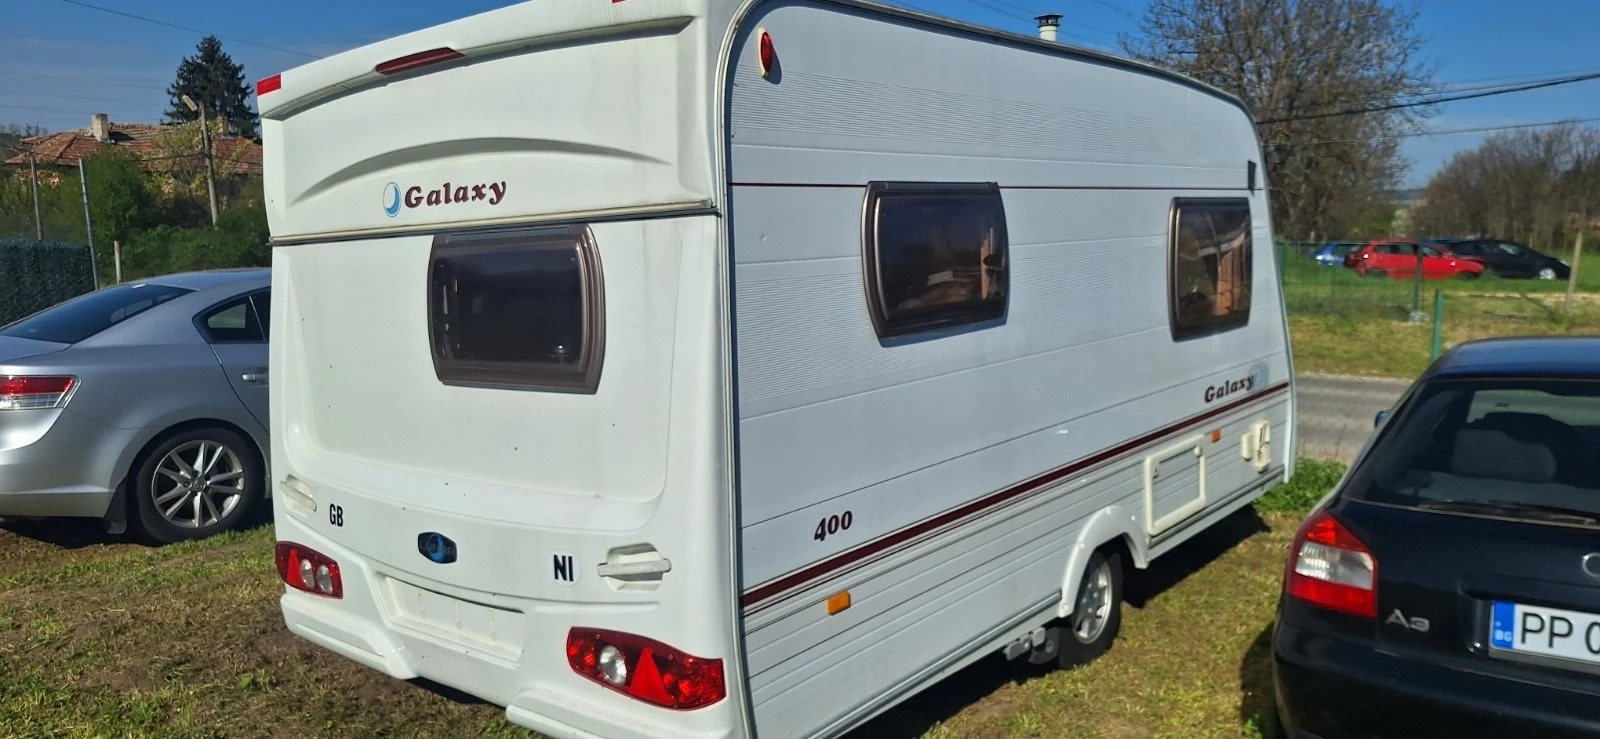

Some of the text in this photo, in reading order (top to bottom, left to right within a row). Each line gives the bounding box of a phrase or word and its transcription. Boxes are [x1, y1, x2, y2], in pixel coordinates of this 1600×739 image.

[404, 181, 507, 209] Galaxy
[1204, 375, 1255, 404] Galaxy
[329, 503, 344, 528] GB
[814, 510, 853, 542] 400
[553, 554, 574, 582] NI
[1385, 608, 1430, 633] A3
[1521, 612, 1573, 648] PP
[1494, 629, 1512, 643] BG
